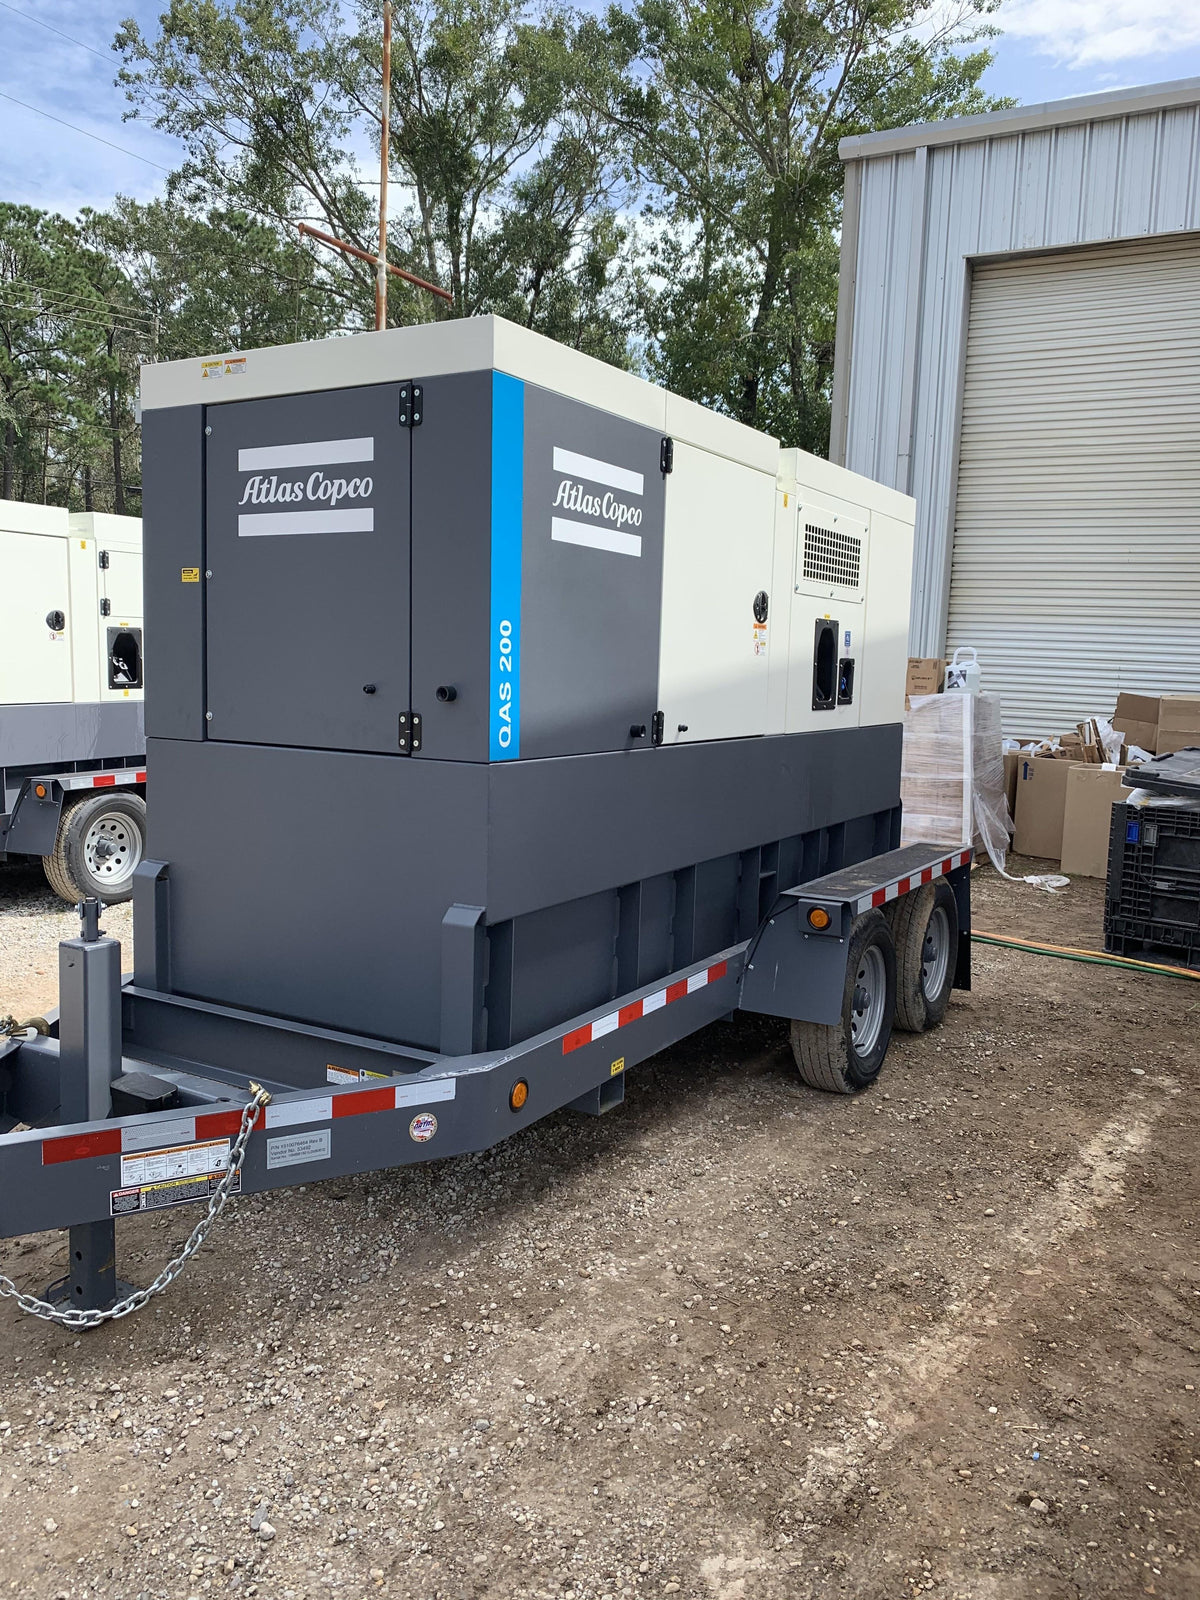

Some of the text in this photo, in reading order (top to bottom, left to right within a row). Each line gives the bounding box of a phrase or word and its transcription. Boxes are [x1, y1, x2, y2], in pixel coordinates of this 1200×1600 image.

[238, 471, 373, 506] Atlas Copco
[552, 480, 642, 528] Atlas Copco
[498, 619, 512, 748] QAS 200
